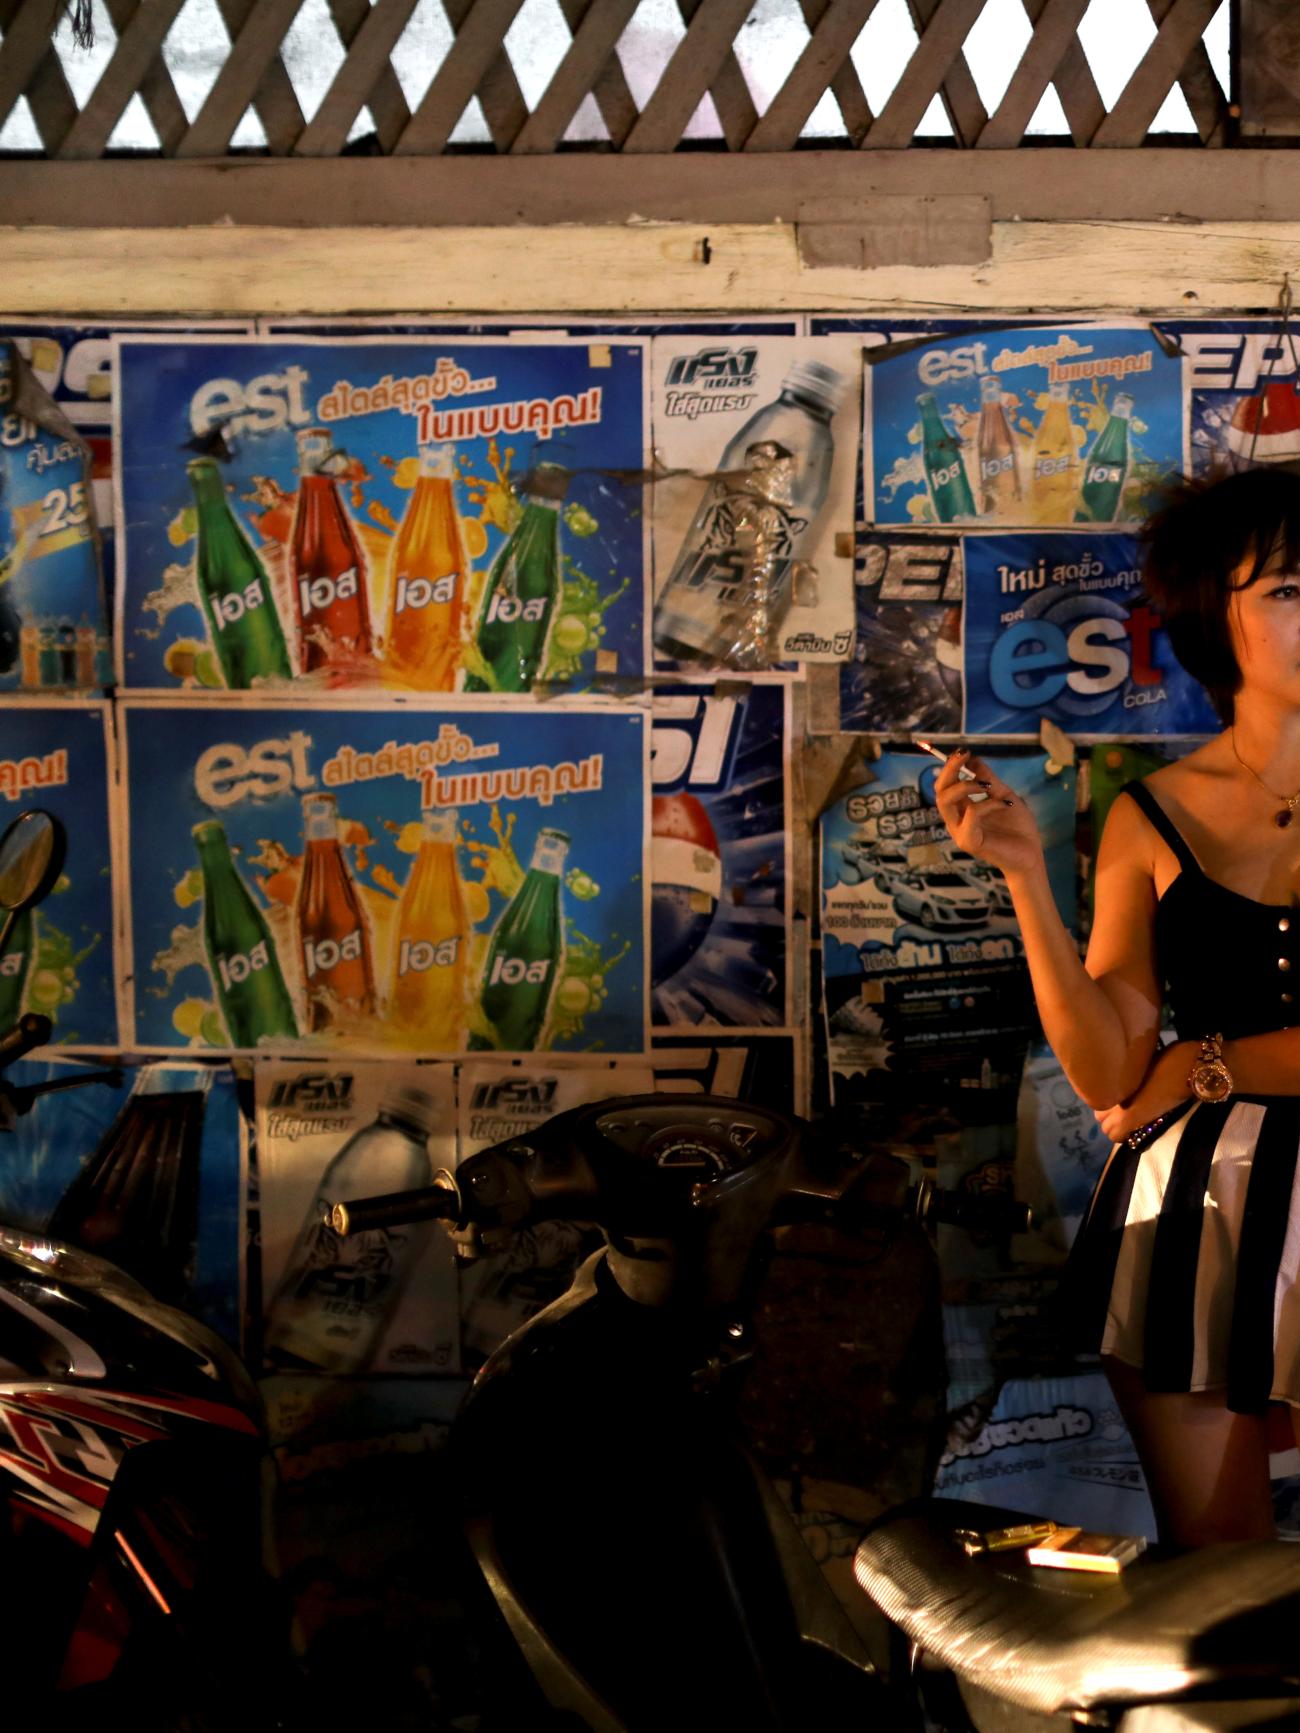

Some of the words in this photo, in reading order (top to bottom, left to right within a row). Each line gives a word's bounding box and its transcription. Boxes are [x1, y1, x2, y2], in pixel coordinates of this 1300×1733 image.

[918, 342, 989, 386] est
[189, 364, 311, 437] est
[417, 386, 602, 445] ในแบบคุณ!
[997, 559, 1047, 594] ใหม่
[990, 606, 1162, 709] est
[1123, 689, 1167, 708] COLA
[194, 730, 316, 806] est
[420, 754, 603, 810] ในแบบคุณ!
